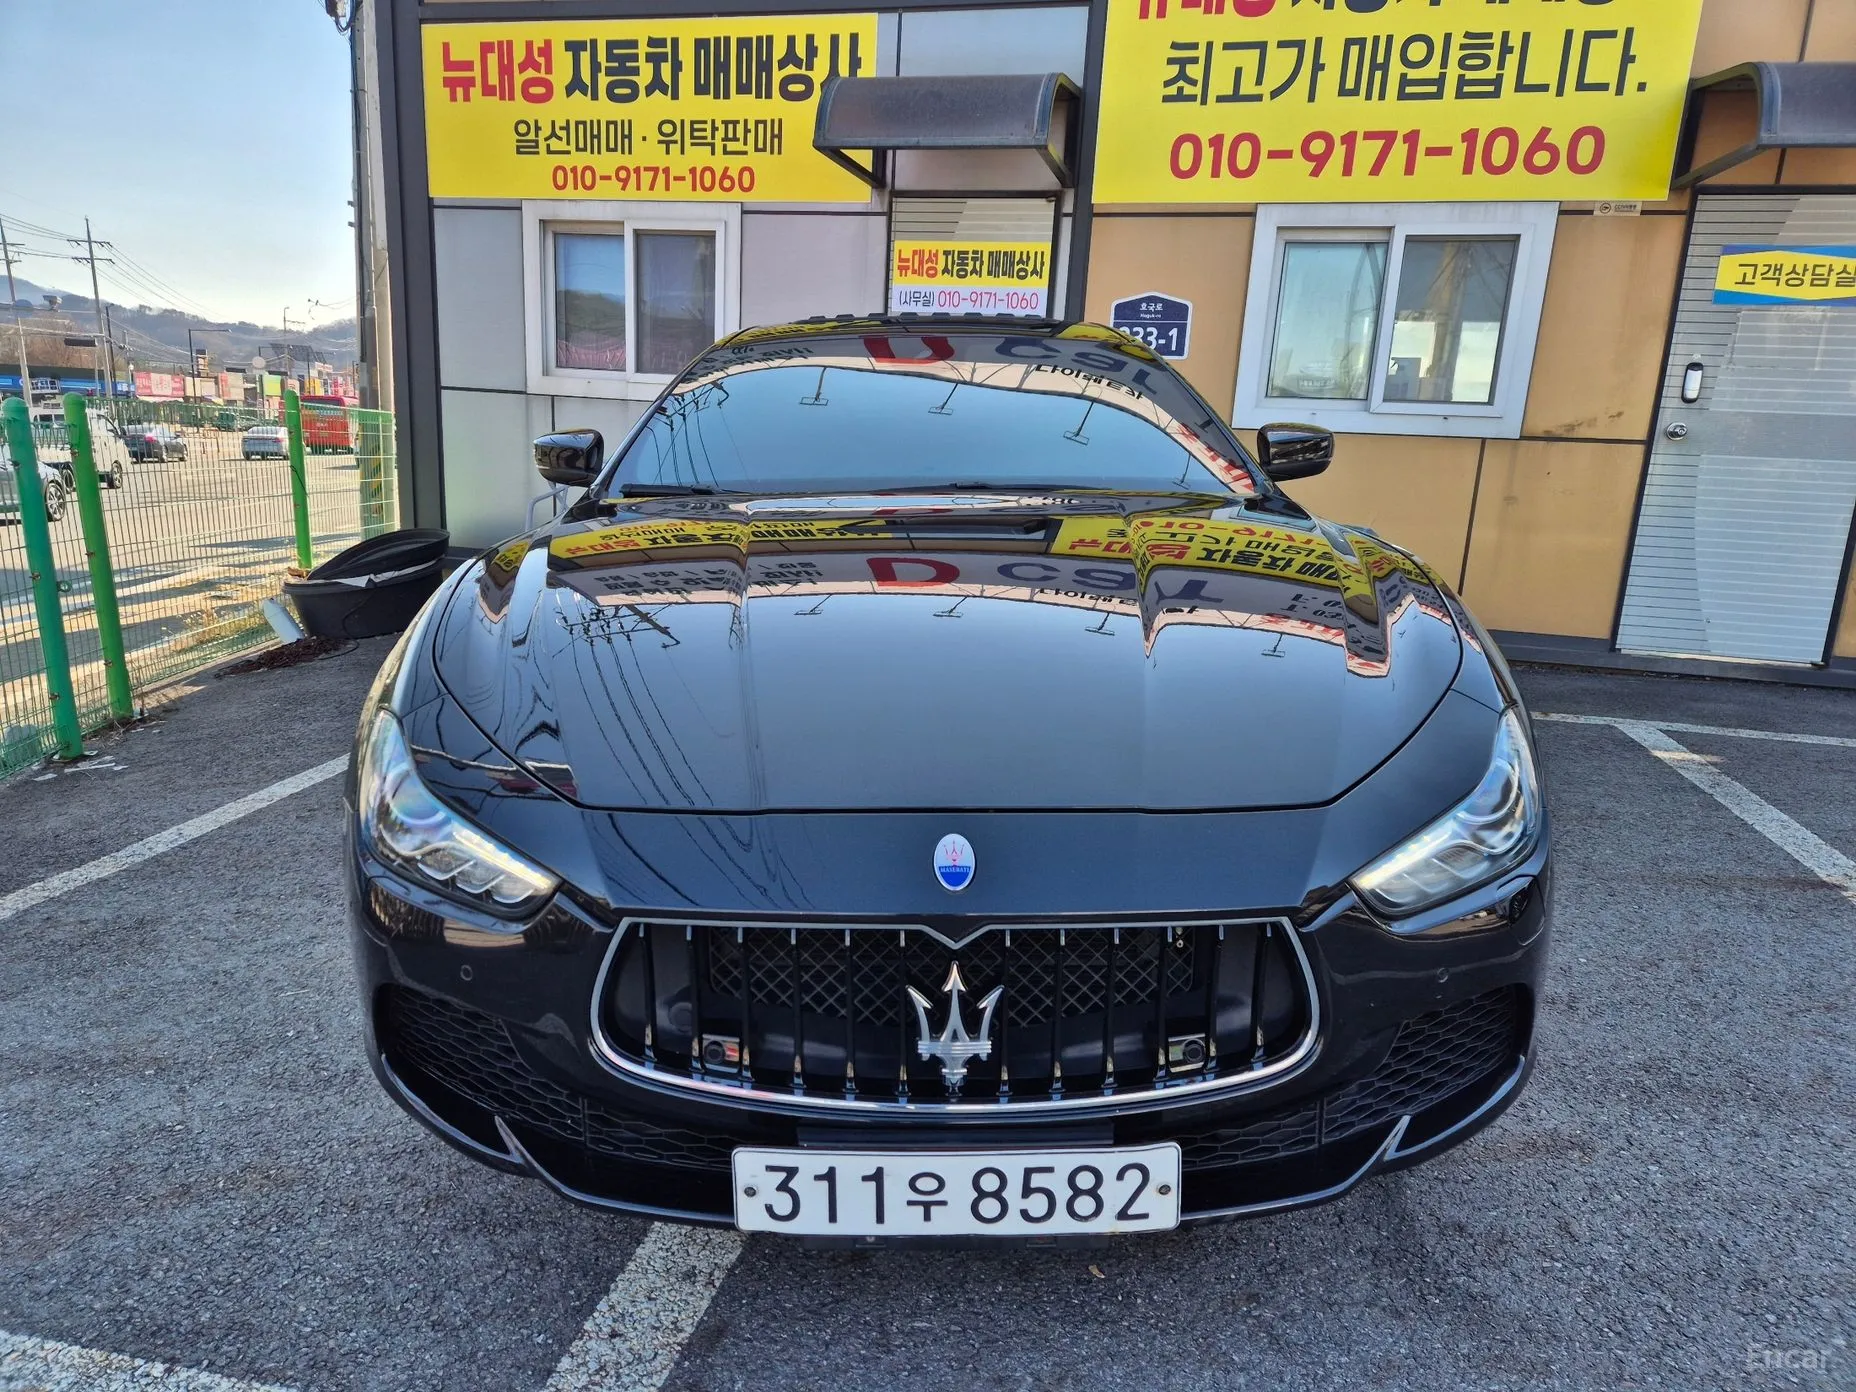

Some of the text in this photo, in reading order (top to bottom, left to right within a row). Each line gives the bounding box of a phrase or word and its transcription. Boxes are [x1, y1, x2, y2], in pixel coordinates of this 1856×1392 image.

[442, 33, 861, 103] 뉴대성 자동차 매매상사
[1162, 27, 1647, 105] 최고가 매입합니다.
[1169, 126, 1606, 179] 010-9171-1060
[552, 165, 755, 193] 010-9171-1060
[897, 249, 1045, 280] 뉴대성 자동차 매매상사
[1734, 263, 1856, 288] 고객상담실
[899, 290, 1039, 310] (사무실) 010-9171-1060
[1140, 302, 1163, 312] 호국로
[1119, 326, 1178, 351] 33-1
